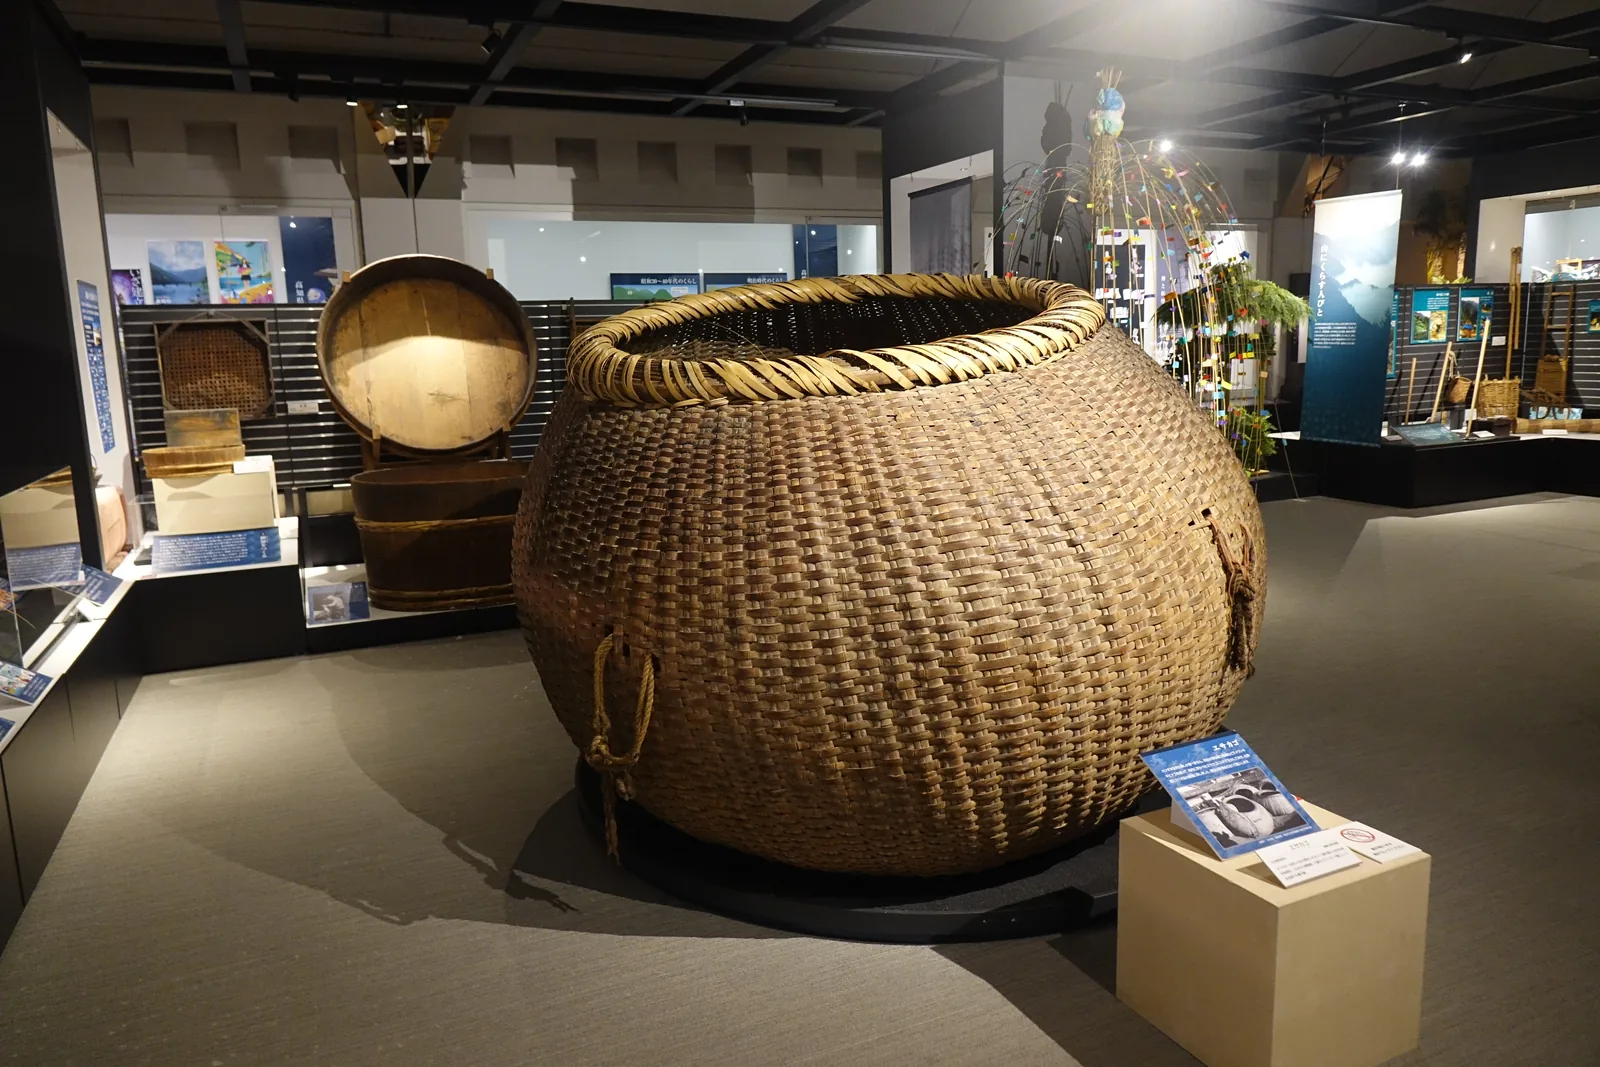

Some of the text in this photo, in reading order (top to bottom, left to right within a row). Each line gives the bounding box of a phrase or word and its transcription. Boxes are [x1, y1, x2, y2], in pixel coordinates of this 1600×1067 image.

[1317, 243, 1329, 317] 山にくらす人びと
[1212, 738, 1240, 751] エサカゴ
